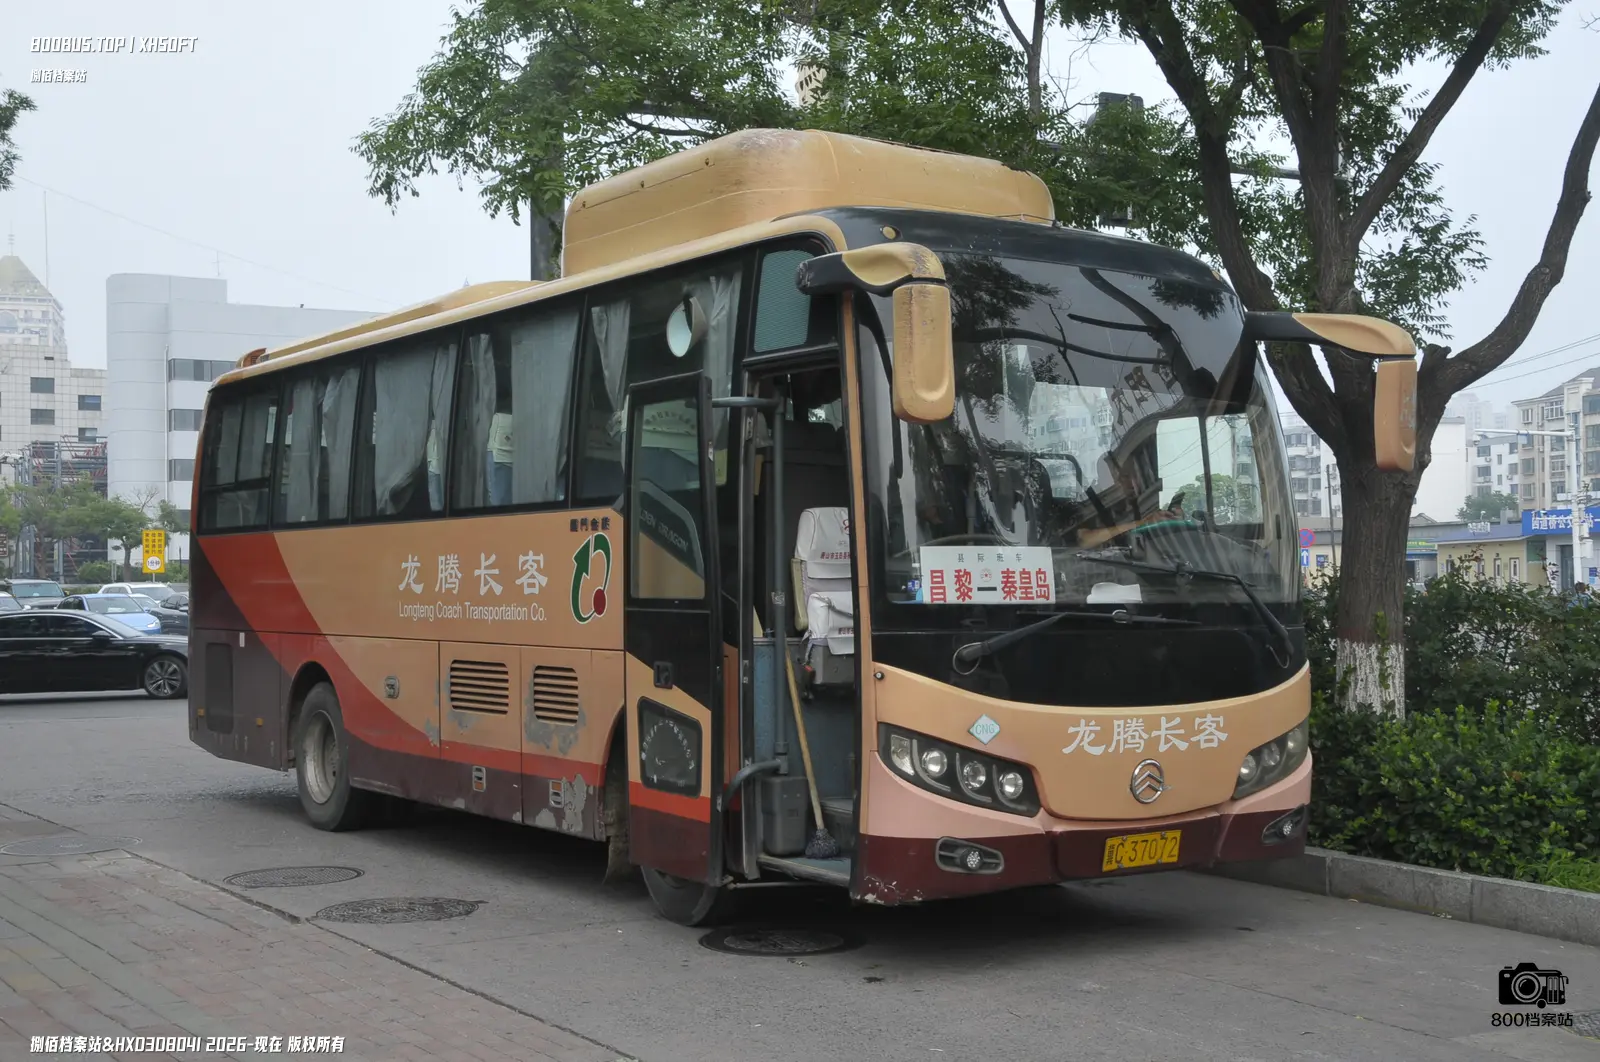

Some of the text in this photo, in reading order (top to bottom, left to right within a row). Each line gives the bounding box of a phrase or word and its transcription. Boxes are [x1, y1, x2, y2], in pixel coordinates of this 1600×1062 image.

[398, 550, 548, 596] 龙腾长客
[399, 601, 548, 624] Longteng Coach Transportation Co.
[975, 723, 996, 735] CNG
[1062, 714, 1228, 755] 龙腾长客
